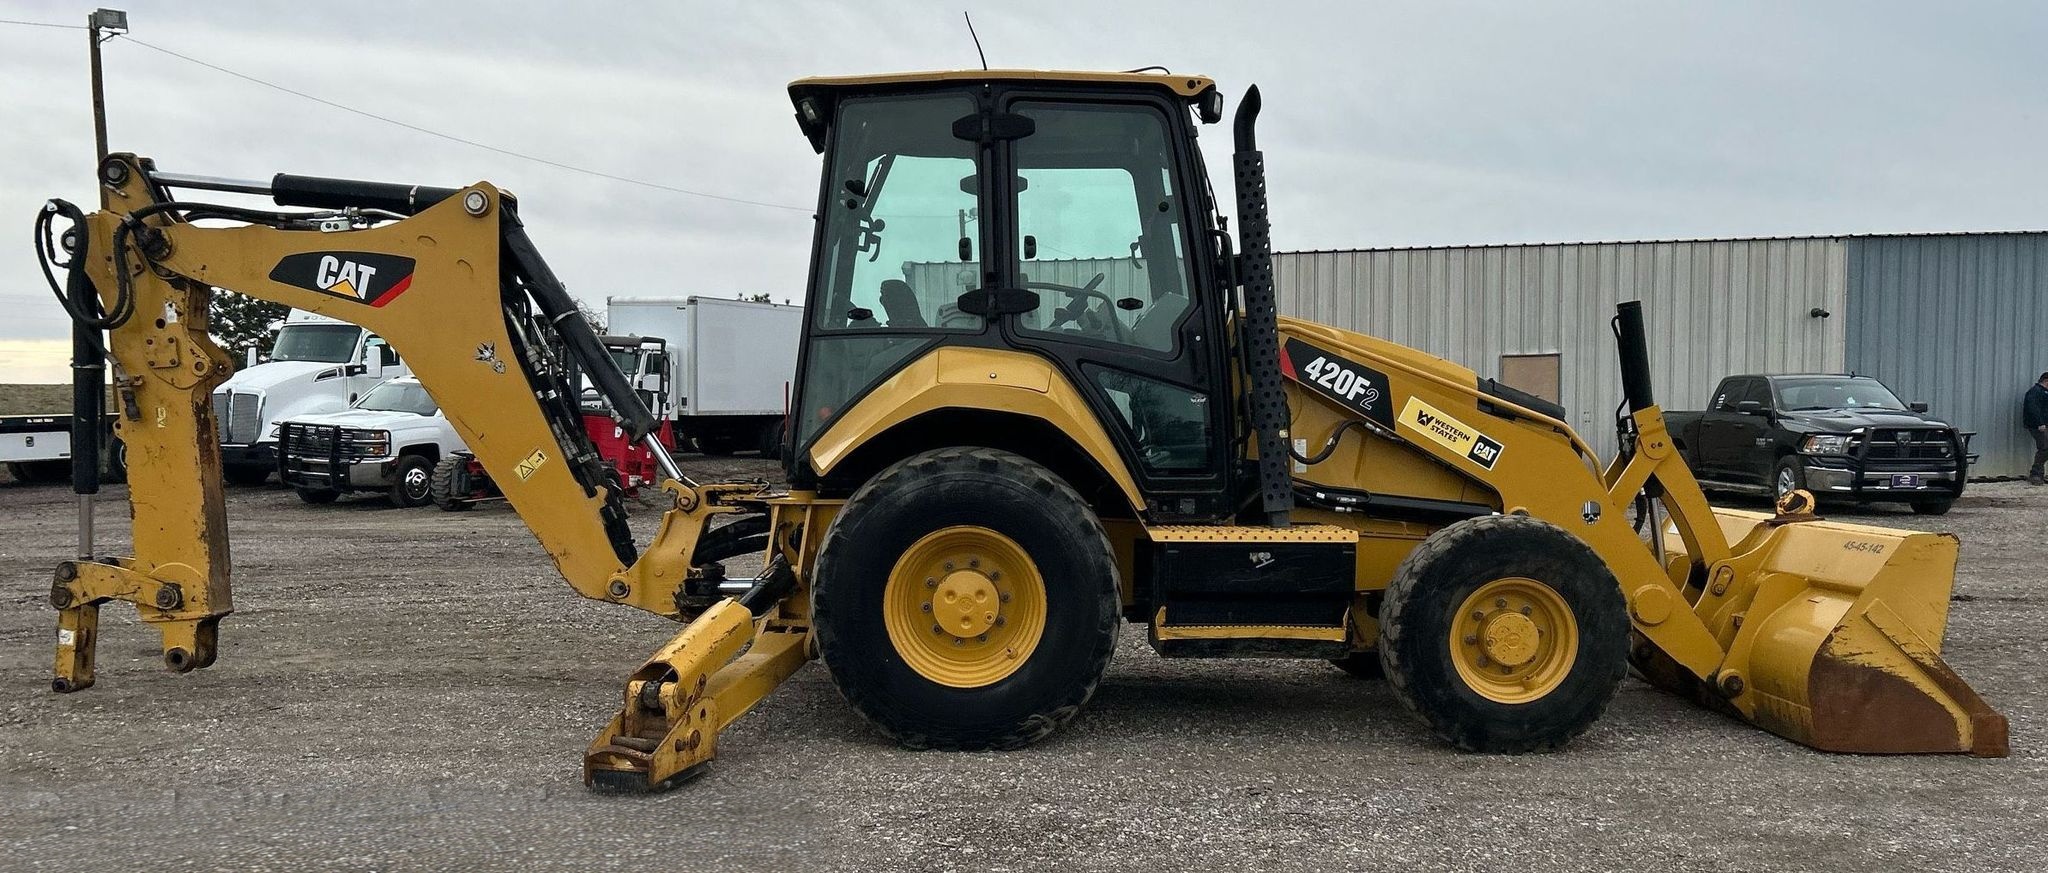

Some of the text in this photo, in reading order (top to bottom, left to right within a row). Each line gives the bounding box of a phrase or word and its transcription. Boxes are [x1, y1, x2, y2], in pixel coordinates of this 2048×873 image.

[316, 255, 377, 300] CAT
[1430, 425, 1458, 443] STATES
[1434, 418, 1471, 442] WESTERN
[1473, 441, 1498, 461] CAT
[1843, 540, 1885, 554] 45-45-142
